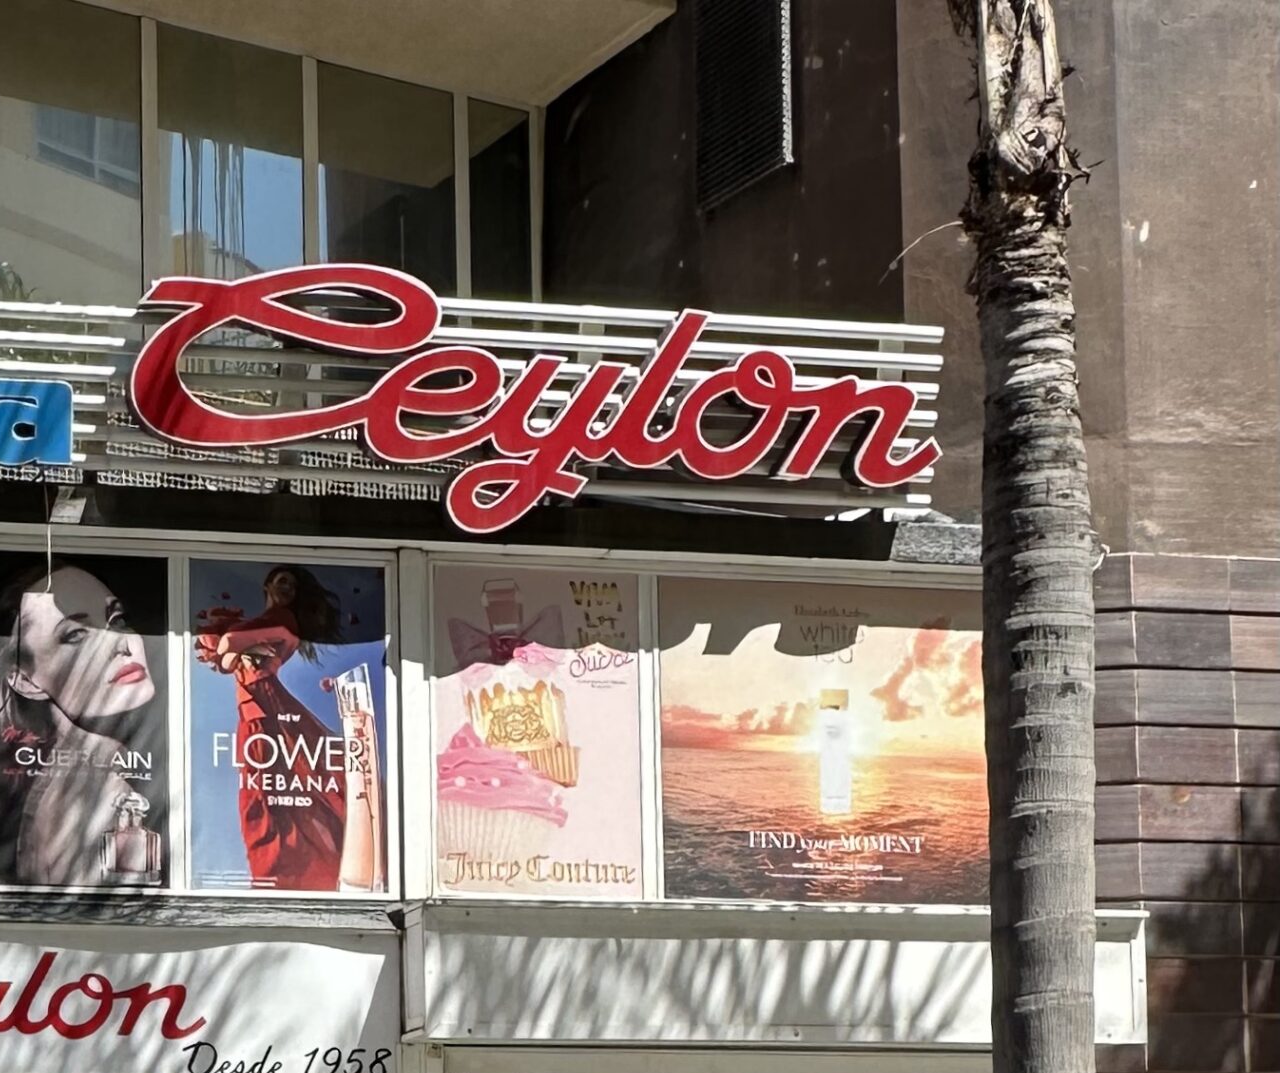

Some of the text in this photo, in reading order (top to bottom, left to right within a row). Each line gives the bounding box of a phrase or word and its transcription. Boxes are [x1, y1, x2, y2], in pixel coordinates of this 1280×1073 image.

[131, 262, 943, 534] Ceylon
[213, 732, 367, 772] FLOWER
[238, 774, 339, 793] IKEBANA
[748, 830, 796, 849] FIND
[841, 834, 925, 853] MOMENT
